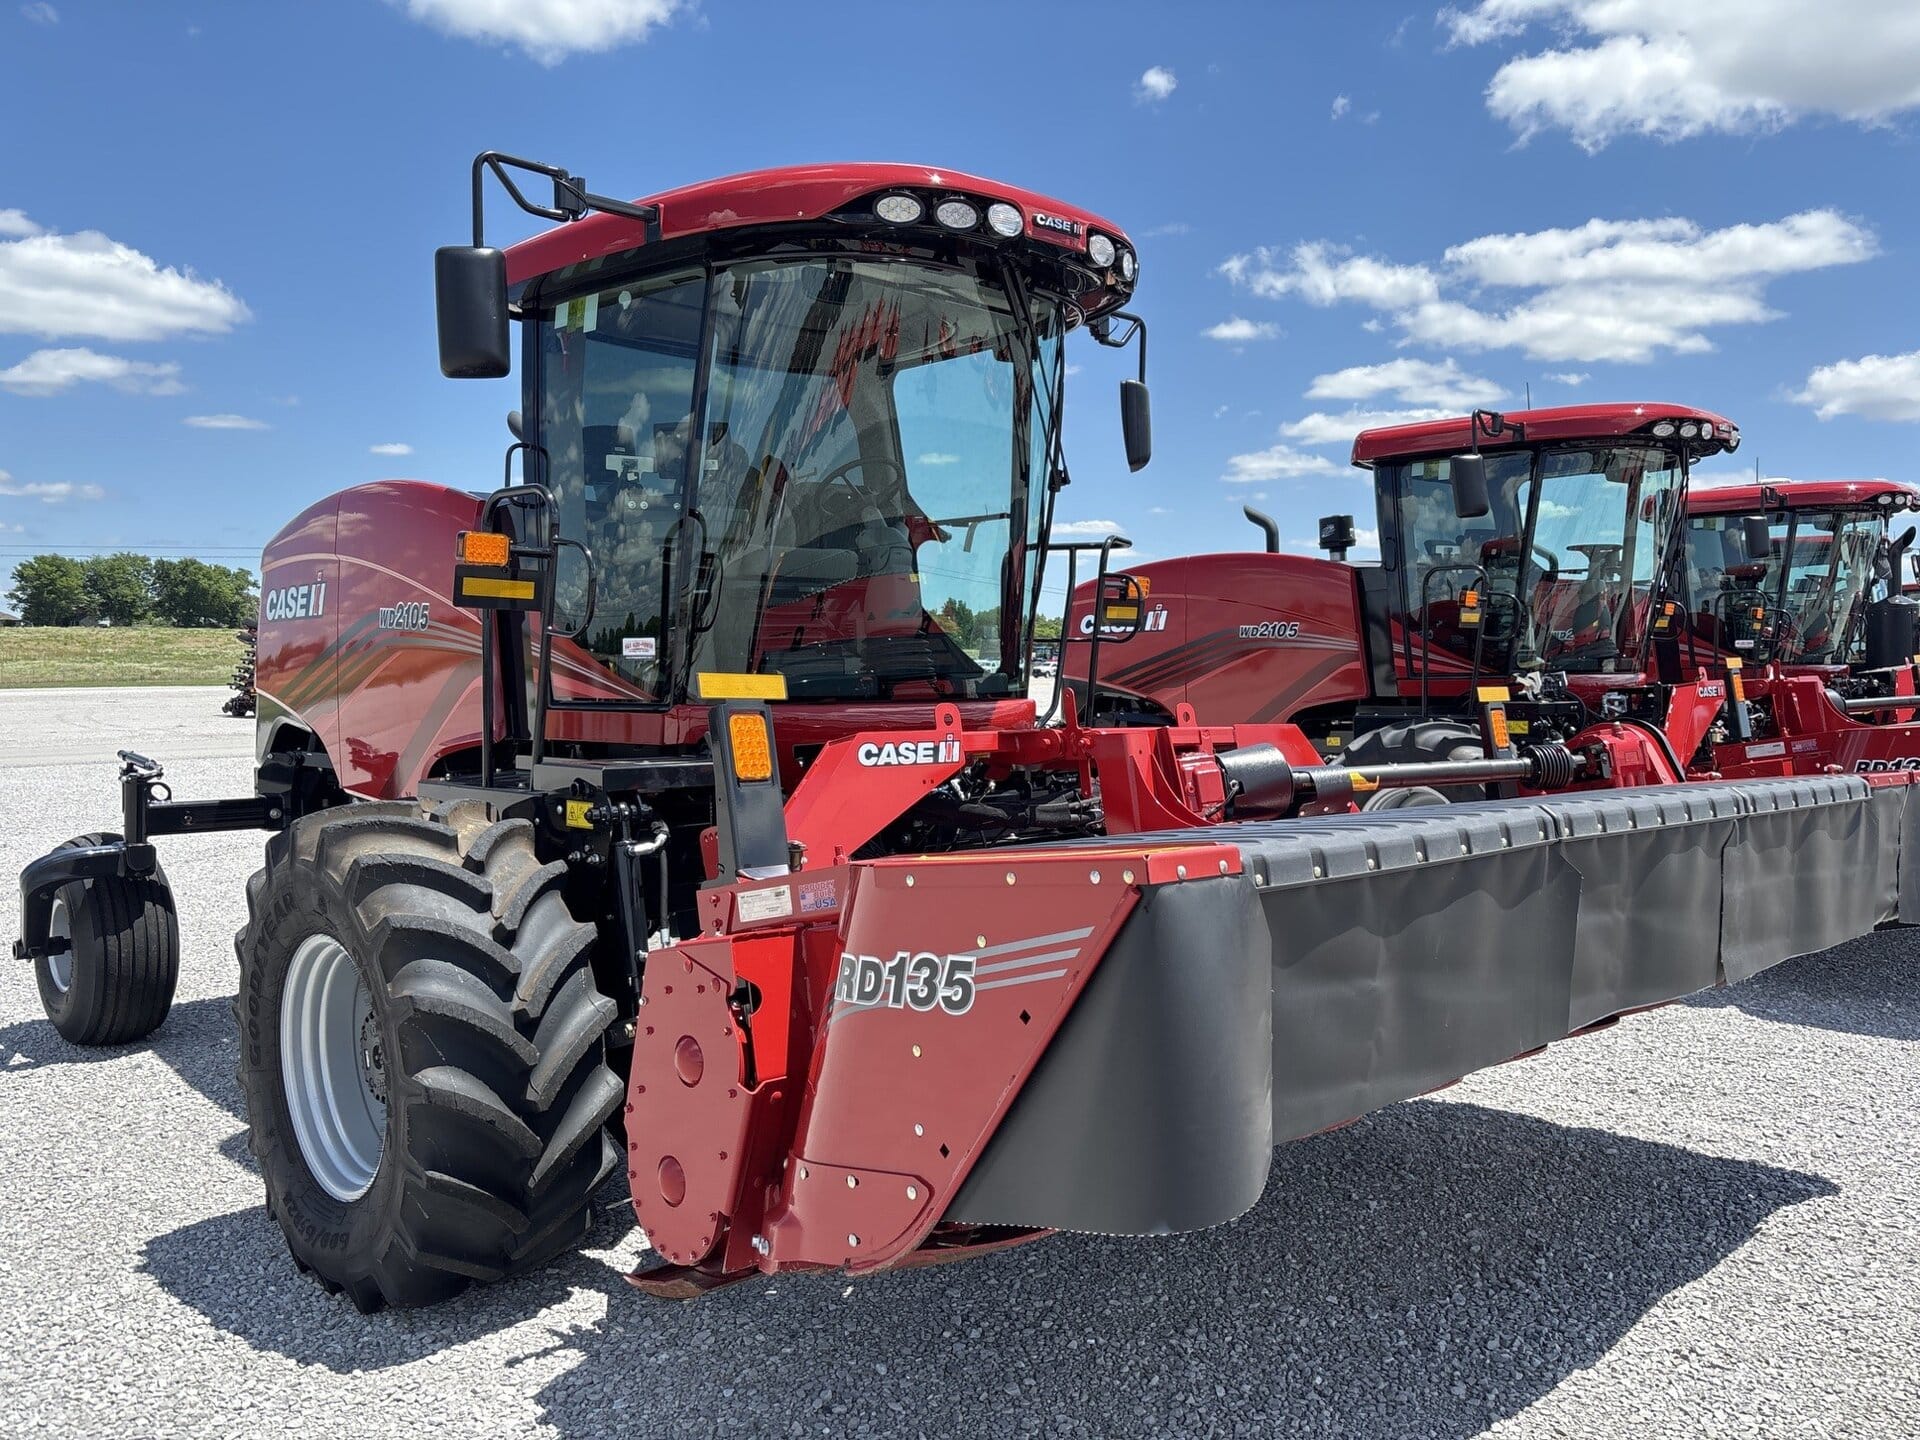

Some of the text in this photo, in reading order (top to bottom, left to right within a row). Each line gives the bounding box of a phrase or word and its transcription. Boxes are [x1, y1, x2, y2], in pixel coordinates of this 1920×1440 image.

[1036, 213, 1071, 232] CASE
[266, 584, 309, 621] CASE
[379, 601, 430, 631] WD2105
[1239, 621, 1300, 640] WD2105
[1698, 686, 1718, 698] CASE
[858, 740, 935, 766] CASE
[815, 897, 837, 909] USA
[834, 951, 977, 1016] RD135
